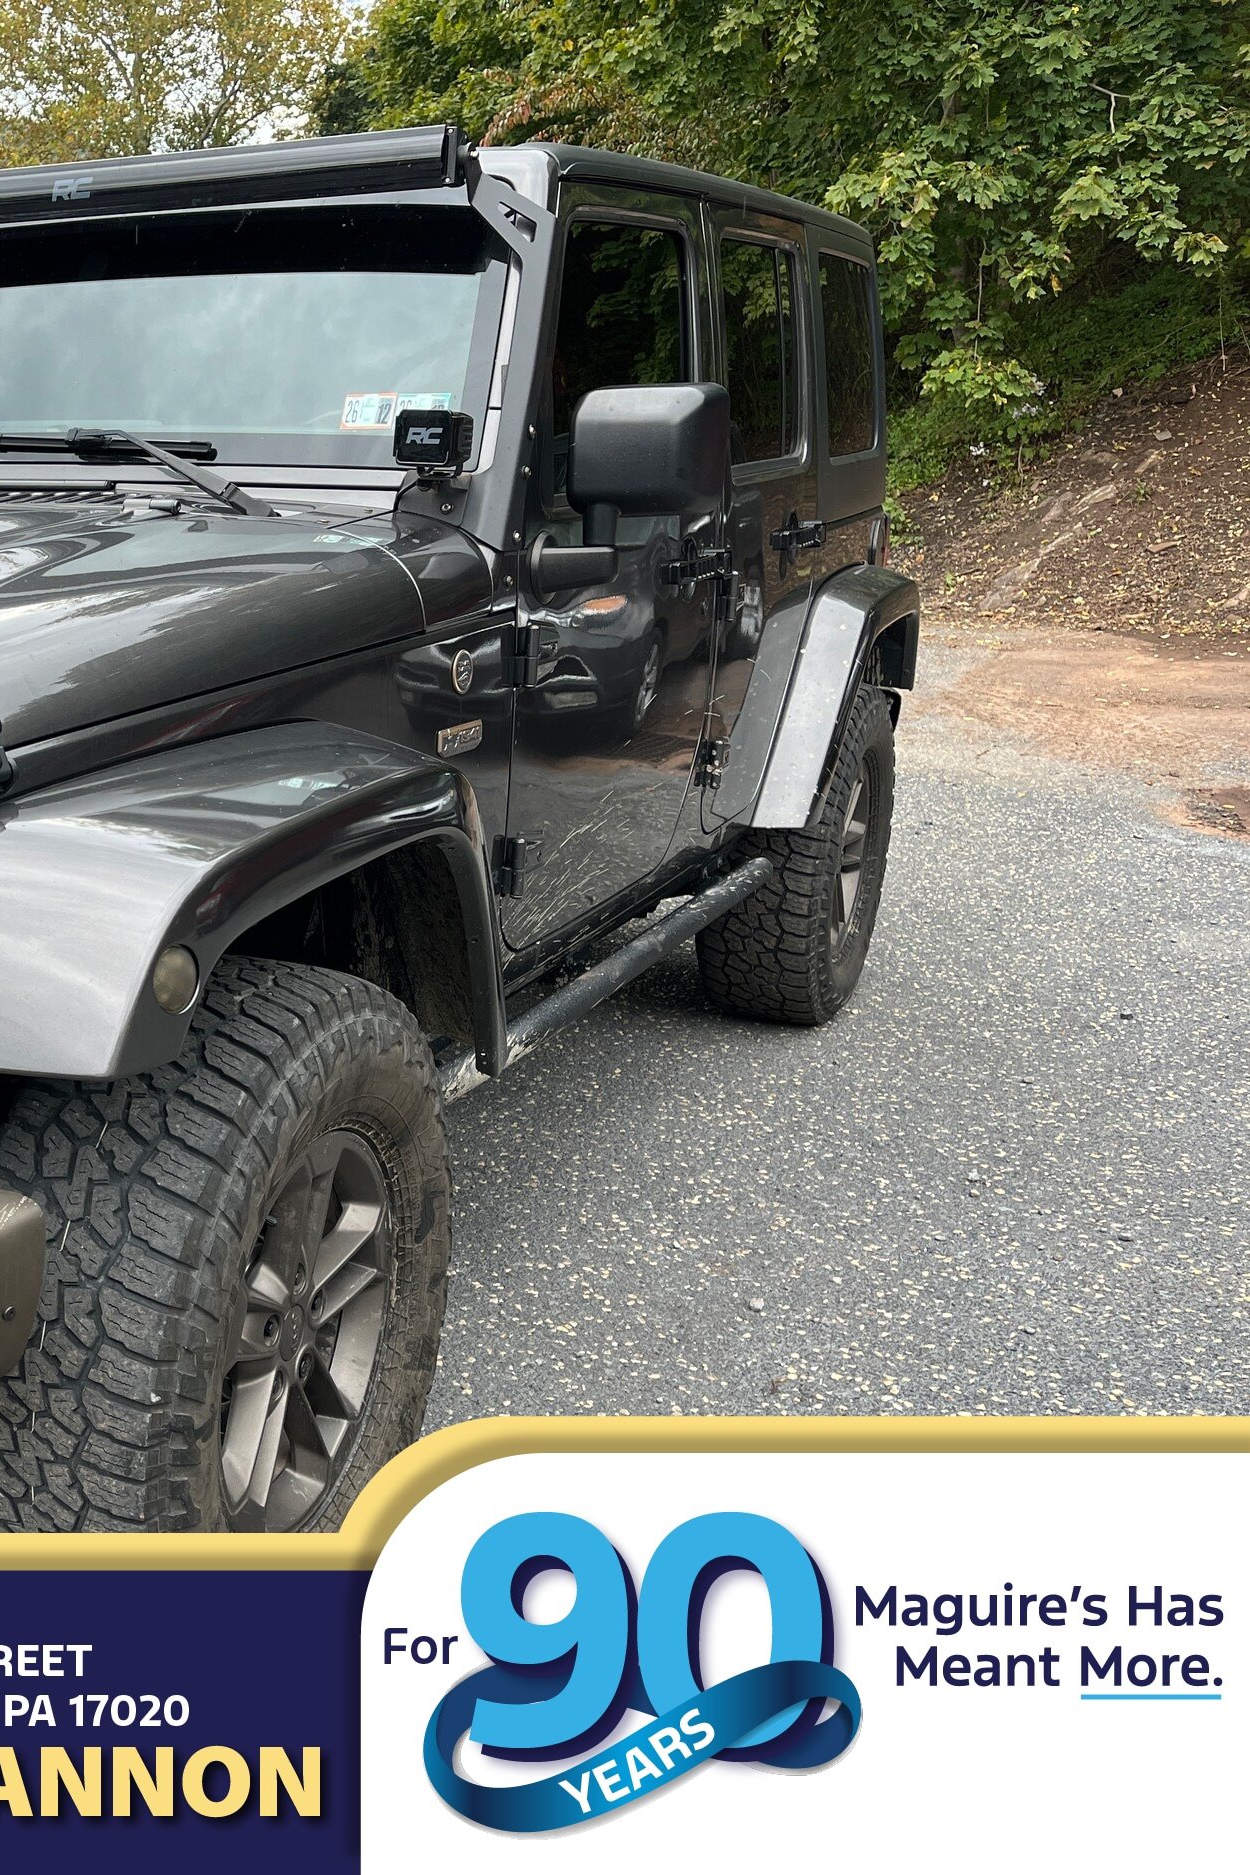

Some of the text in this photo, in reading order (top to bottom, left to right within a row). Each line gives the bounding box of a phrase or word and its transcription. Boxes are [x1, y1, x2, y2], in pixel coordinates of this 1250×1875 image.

[51, 176, 94, 202] RC
[345, 400, 359, 423] 26
[375, 403, 392, 424] 12
[406, 427, 444, 445] RC
